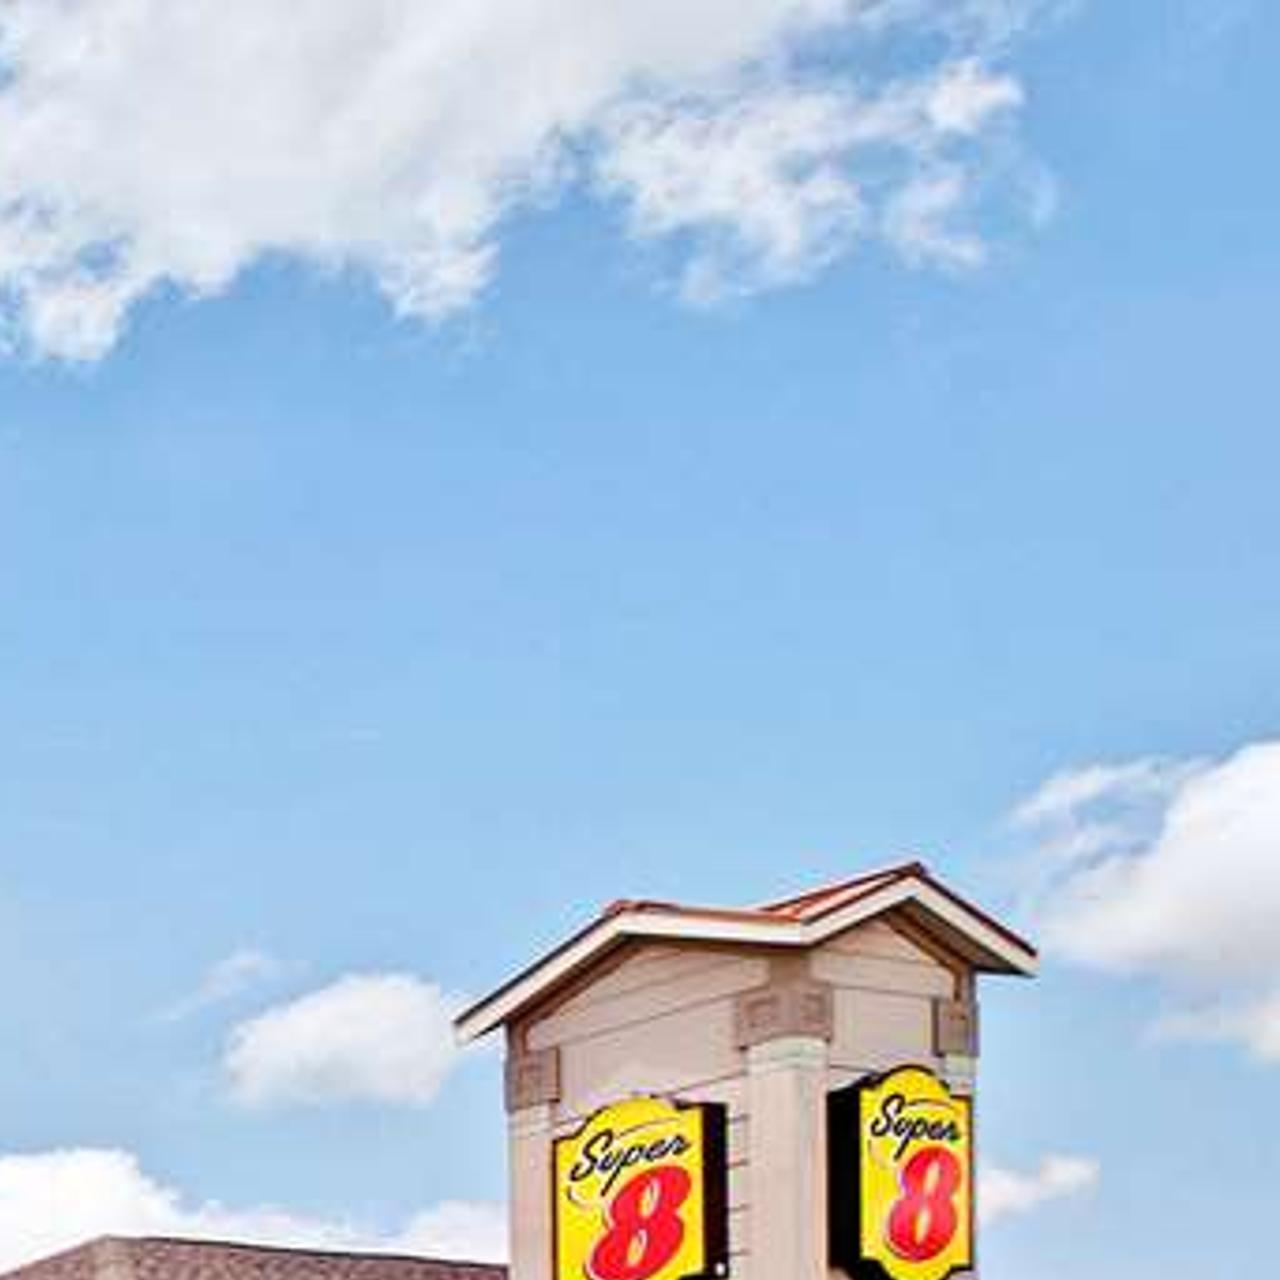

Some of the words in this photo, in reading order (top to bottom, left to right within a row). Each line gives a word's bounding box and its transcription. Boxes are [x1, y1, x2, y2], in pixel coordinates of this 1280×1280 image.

[570, 1128, 692, 1196] Super
[870, 1093, 961, 1163] Super
[886, 1145, 961, 1262] 8
